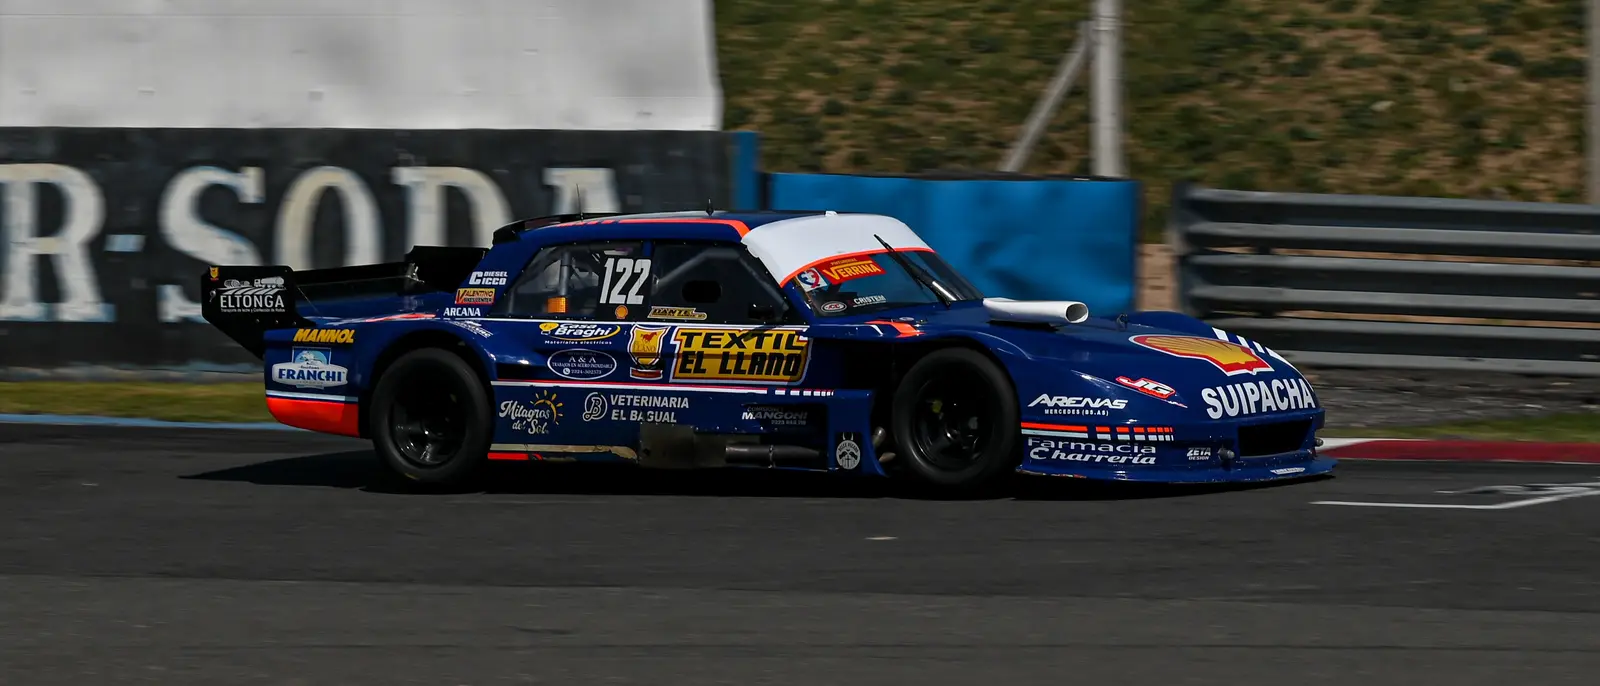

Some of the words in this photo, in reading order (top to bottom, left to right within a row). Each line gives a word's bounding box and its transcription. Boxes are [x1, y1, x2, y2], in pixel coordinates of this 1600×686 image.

[469, 271, 507, 285] CICCO
[822, 262, 882, 281] VERRINA
[599, 257, 651, 305] 122
[220, 294, 285, 308] ELTONGA
[456, 289, 494, 303] VALENTINO
[853, 295, 887, 305] CRISTEM
[443, 307, 481, 317] ARCANA
[293, 328, 356, 344] MANNOL
[554, 327, 612, 338] Braghi
[680, 331, 808, 350] TEXTIL
[568, 355, 576, 363] A
[577, 355, 586, 363] &
[588, 355, 597, 363] A
[679, 351, 707, 374] EL
[718, 352, 802, 376] LLANO
[278, 368, 342, 382] FRANCHI
[610, 394, 690, 409] VETERINARIA
[1027, 393, 1129, 410] ARENAS
[1201, 378, 1316, 420] SUIPACHA
[498, 400, 550, 423] Milagros
[611, 409, 626, 421] EL
[629, 410, 677, 424] BAGUAL
[741, 410, 809, 420] MANGONI
[527, 418, 549, 435] Sol
[1027, 437, 1157, 454] Farmacia
[1186, 448, 1211, 457] ZETA
[1029, 446, 1157, 465] Charrería
